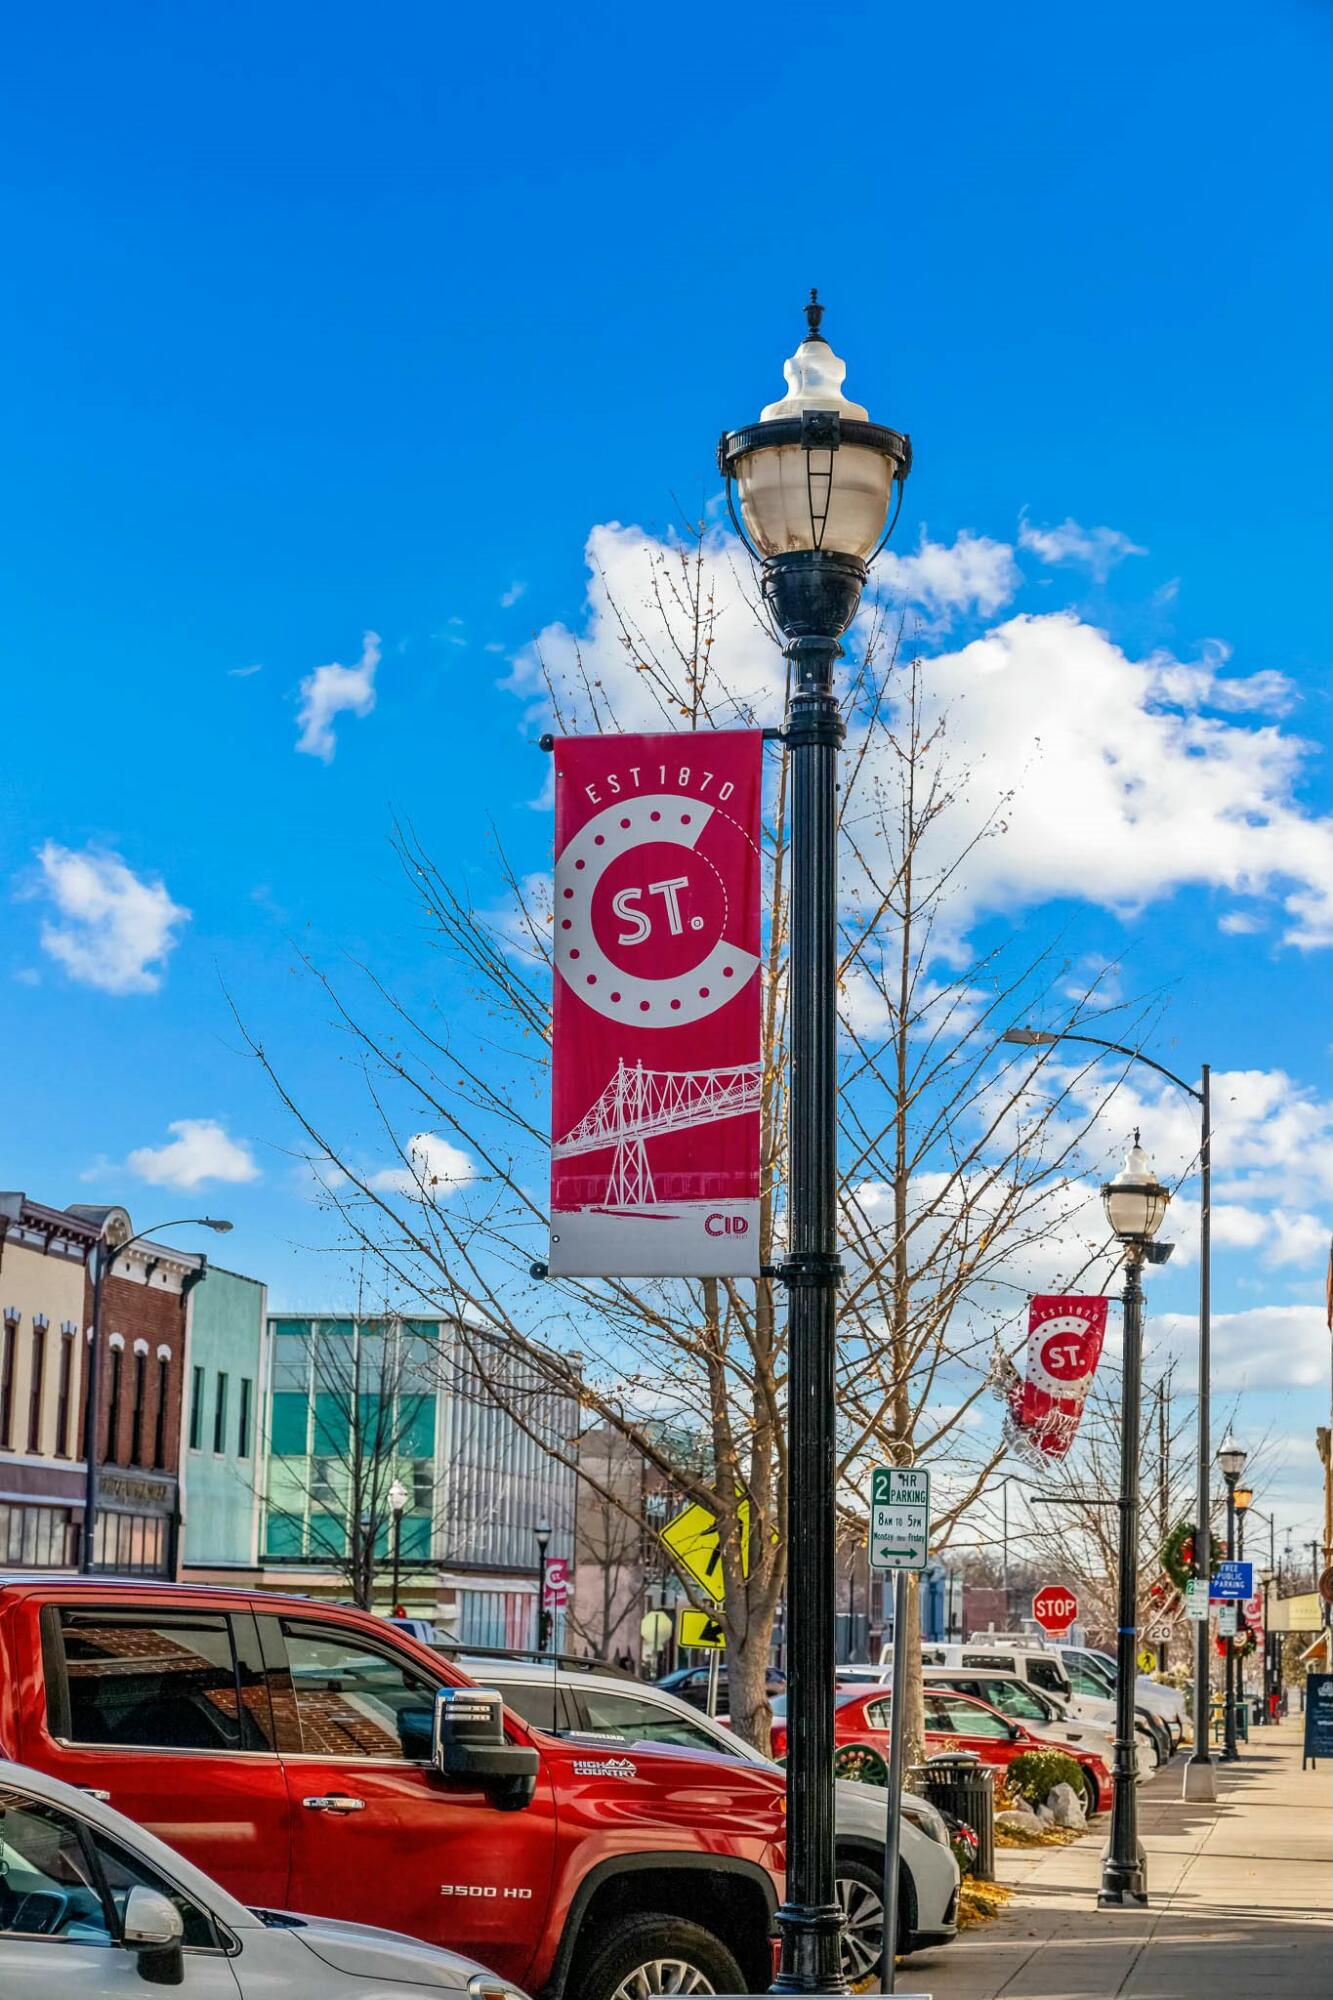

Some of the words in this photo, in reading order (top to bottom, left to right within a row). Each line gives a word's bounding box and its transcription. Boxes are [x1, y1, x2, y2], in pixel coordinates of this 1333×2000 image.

[585, 767, 641, 804] EST
[659, 765, 735, 801] 1870
[612, 876, 704, 946] ST.
[704, 1213, 749, 1237] CID
[1040, 1306, 1063, 1319] EST
[1069, 1306, 1099, 1322] 1870
[1048, 1345, 1086, 1369] ST.
[876, 1475, 888, 1500] 2
[902, 1474, 917, 1487] HR
[890, 1489, 926, 1503] PARKING
[1216, 1572, 1243, 1581] PUBLIC
[1213, 1580, 1246, 1589] PARKING
[1036, 1598, 1075, 1618] STOP
[1151, 1626, 1171, 1639] 20
[573, 1760, 606, 1769] HIGH
[574, 1766, 637, 1778] COUNTRY
[440, 1884, 498, 1898] 3500
[503, 1887, 533, 1899] HD
